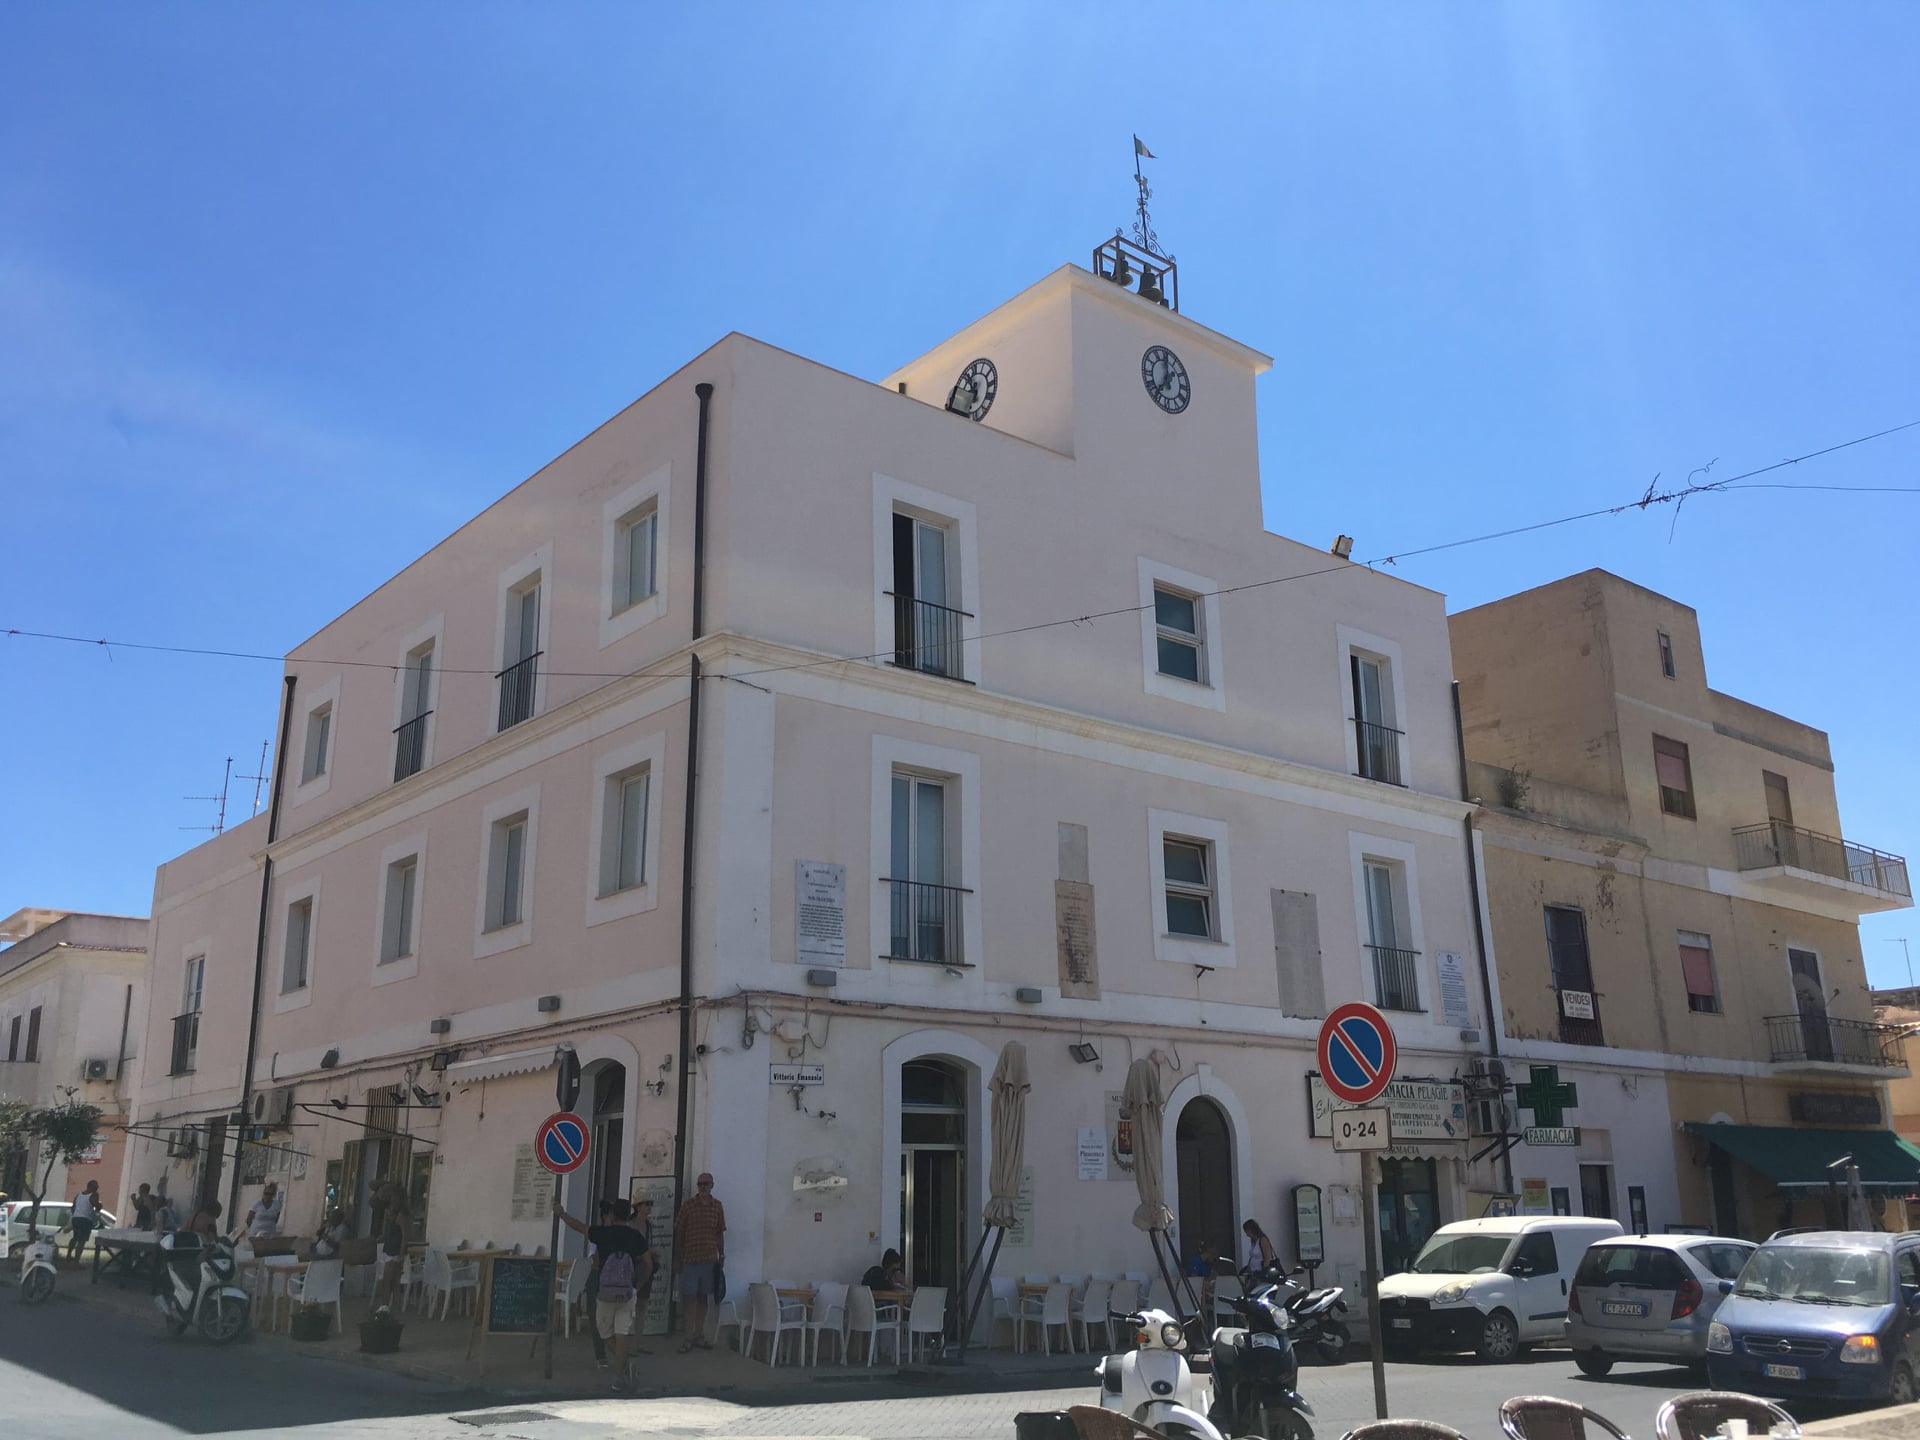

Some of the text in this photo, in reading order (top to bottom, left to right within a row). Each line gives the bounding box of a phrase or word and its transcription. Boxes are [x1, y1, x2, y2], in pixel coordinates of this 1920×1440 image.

[1564, 992, 1591, 1006] VENDESI
[773, 1072, 795, 1081] Vittorio
[1342, 1121, 1377, 1138] 0-24
[1529, 1129, 1574, 1143] FARMACIA
